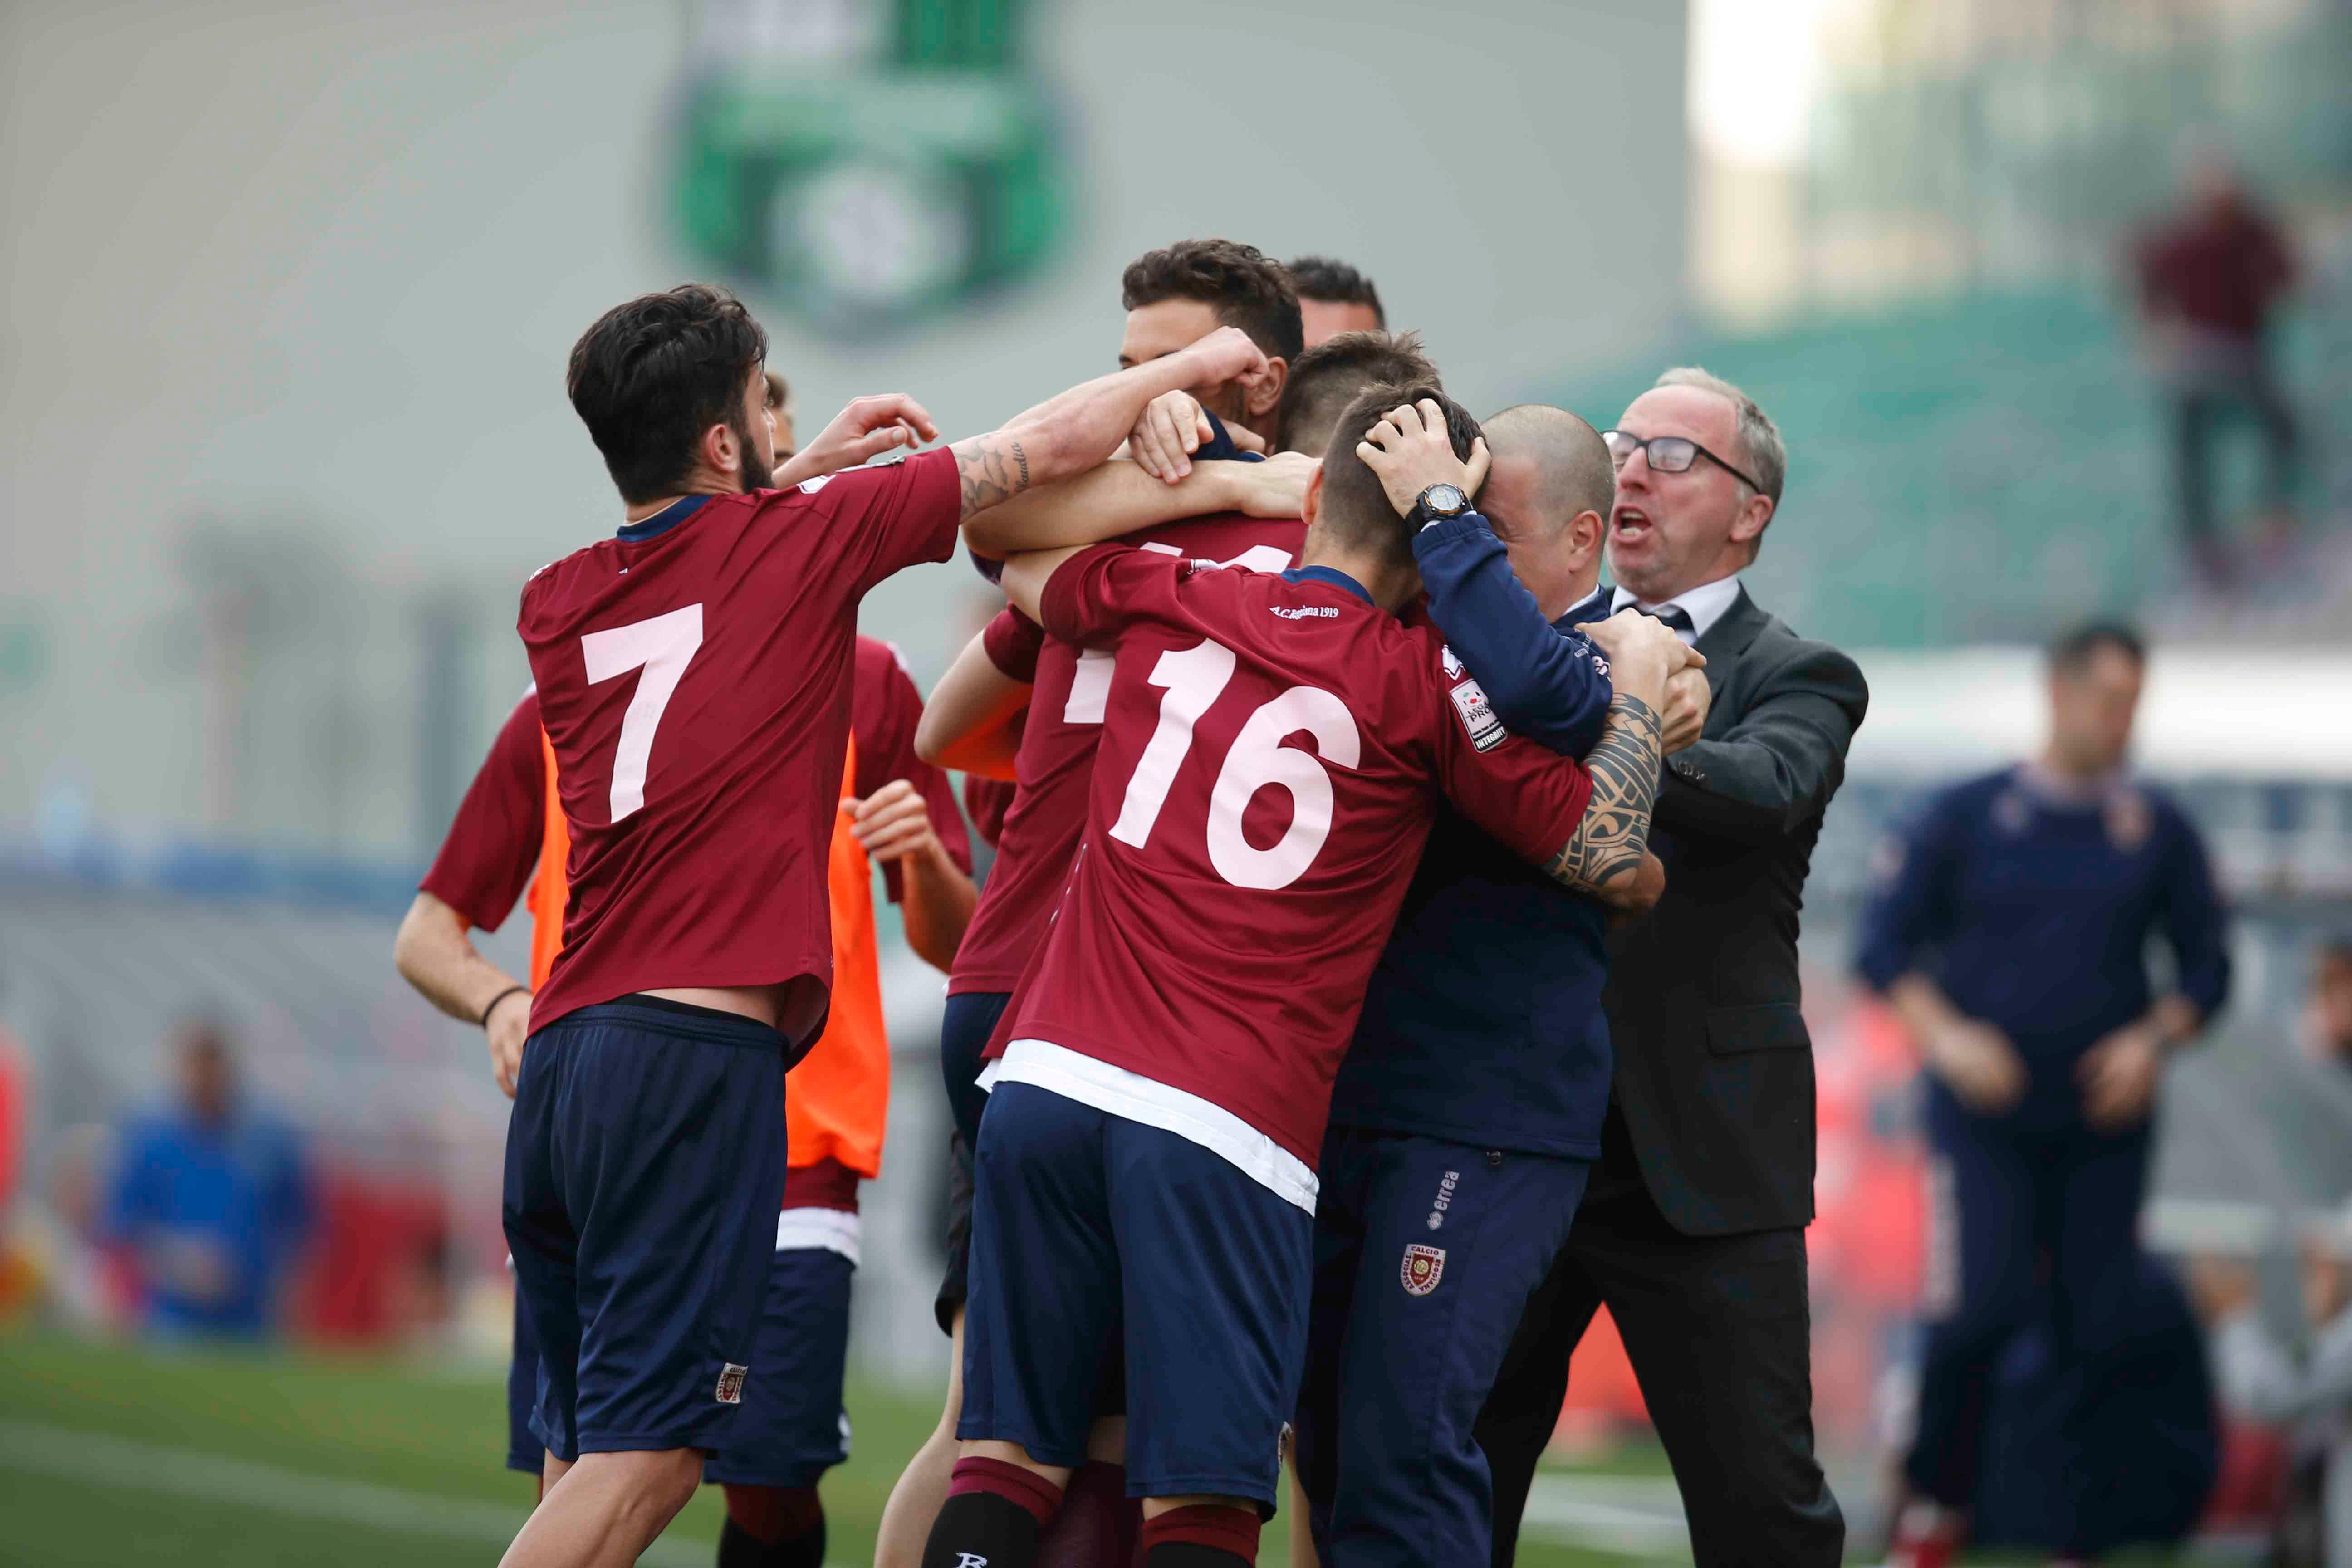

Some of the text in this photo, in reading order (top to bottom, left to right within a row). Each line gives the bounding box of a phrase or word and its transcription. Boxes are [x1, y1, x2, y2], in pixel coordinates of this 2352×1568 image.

[1320, 607, 1339, 617] 1919
[581, 602, 703, 823] 7
[1469, 706, 1491, 722] PRO
[1475, 726, 1505, 749] INTEGRITY
[1108, 637, 1360, 890] 16
[1411, 1246, 1439, 1255] CALCIO
